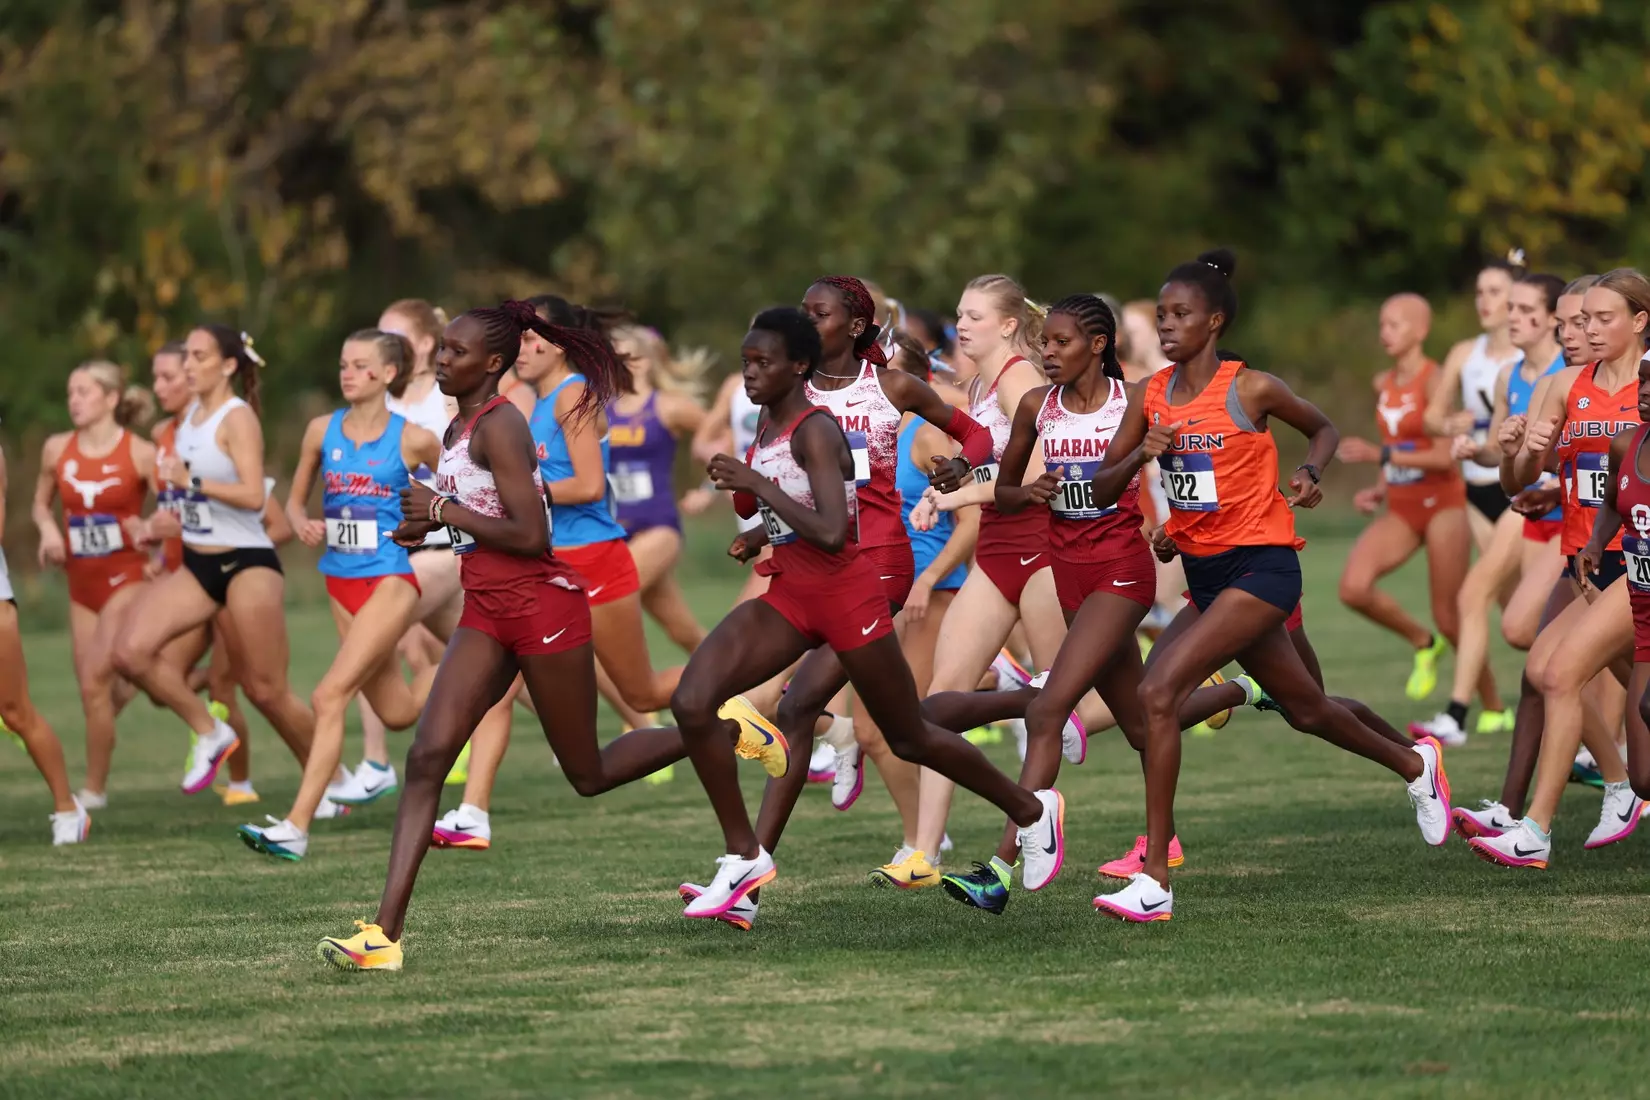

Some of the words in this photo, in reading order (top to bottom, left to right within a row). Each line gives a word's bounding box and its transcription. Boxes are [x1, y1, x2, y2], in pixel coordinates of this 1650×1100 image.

[1044, 438, 1110, 458] ALABAM
[1168, 434, 1224, 451] URN
[1169, 473, 1199, 501] 122
[1590, 472, 1608, 499] 13
[338, 522, 358, 545] 211
[761, 508, 782, 536] 05
[1633, 555, 1650, 584] 20
